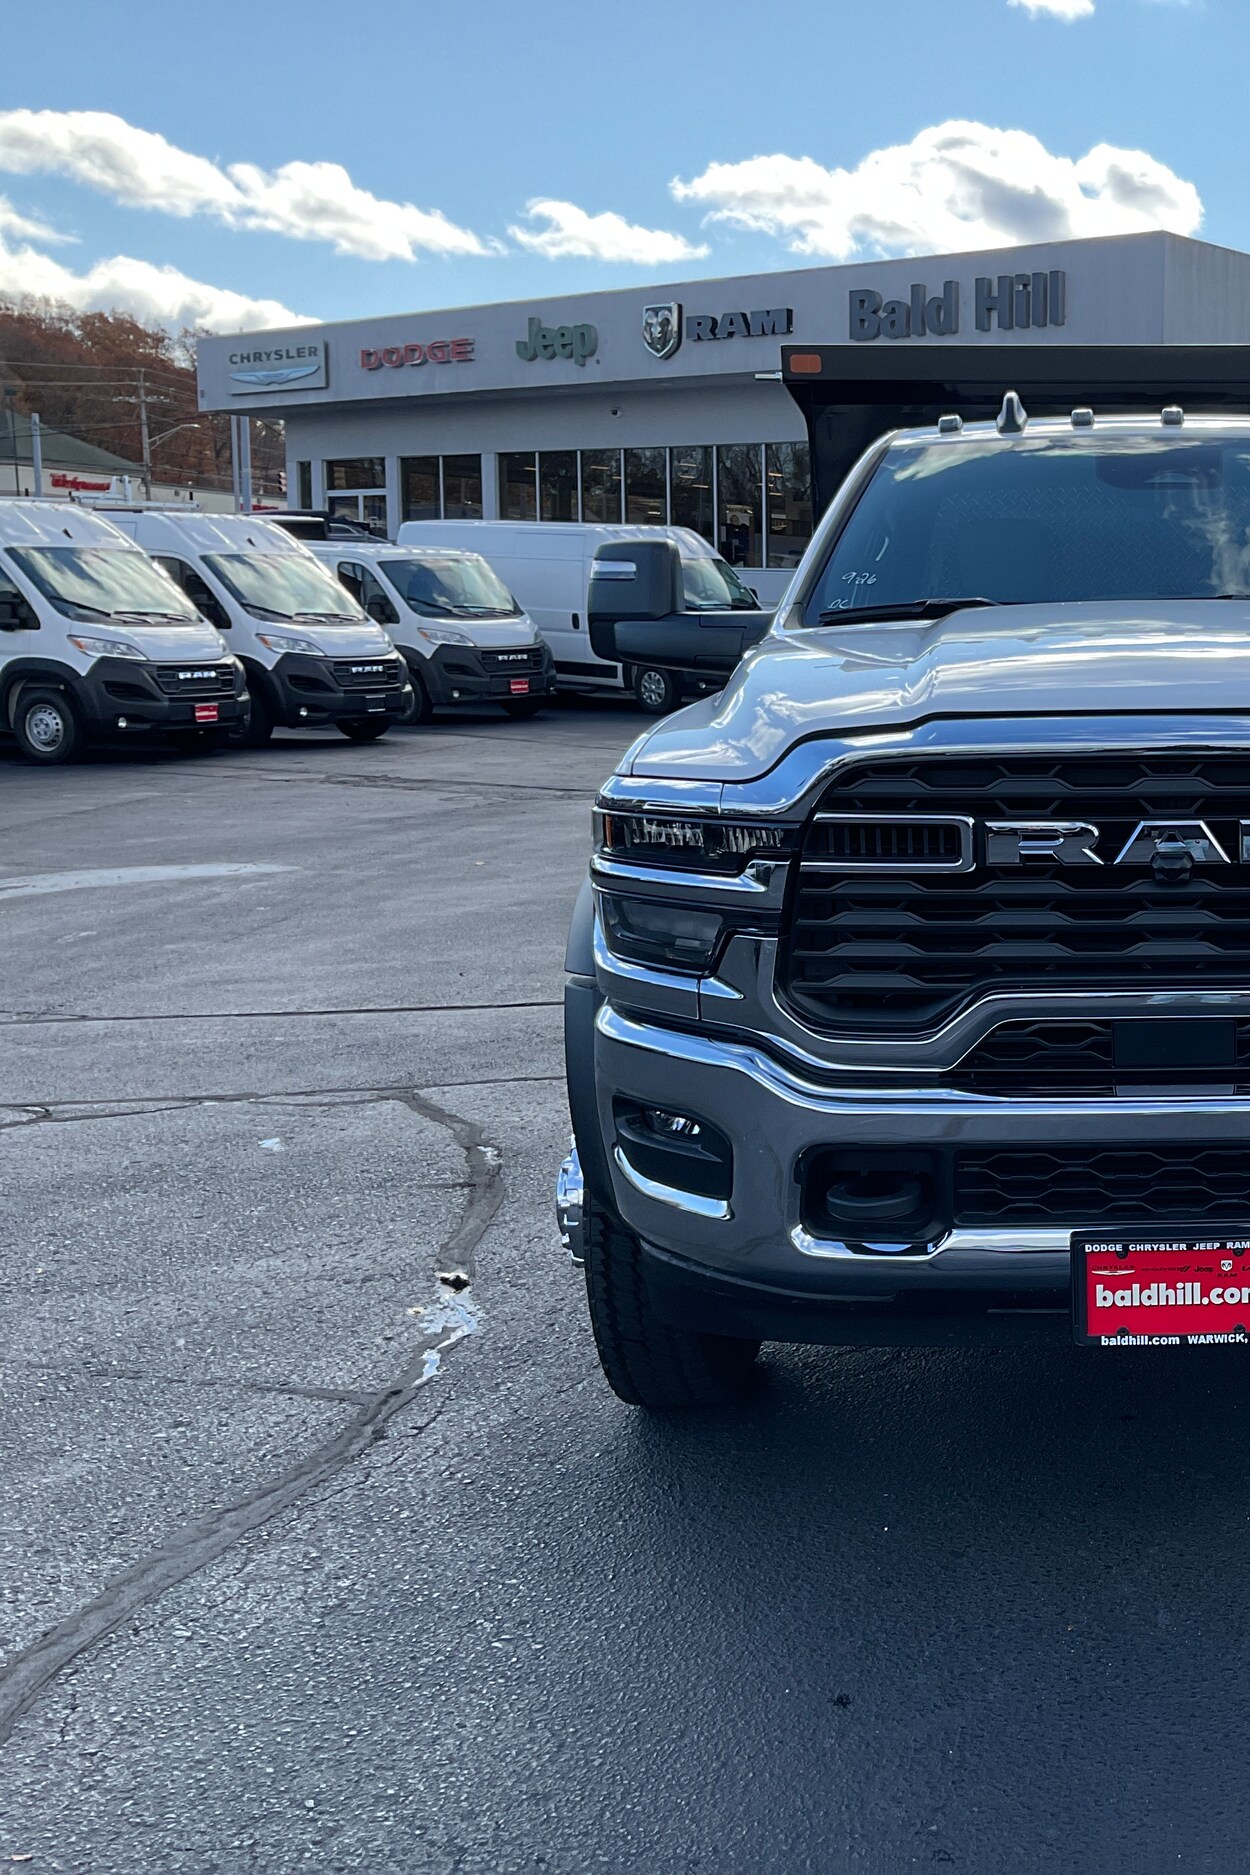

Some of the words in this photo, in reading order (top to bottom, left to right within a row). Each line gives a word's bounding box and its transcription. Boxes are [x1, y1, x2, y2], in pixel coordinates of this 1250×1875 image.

[849, 280, 959, 342] Bald
[975, 270, 1066, 332] Hill
[686, 308, 793, 342] RAM
[360, 338, 475, 371] DODGE
[515, 317, 598, 367] Jeep
[229, 346, 319, 365] CHRYSLER
[178, 670, 217, 680] RAM
[1084, 1243, 1123, 1253] DODGE
[1128, 1243, 1188, 1252] CHRYSLER
[1192, 1242, 1221, 1250] JEEP
[1226, 1241, 1250, 1249] RAM
[1101, 1335, 1180, 1346] baldhill.com
[1187, 1334, 1249, 1344] WARWICK,
